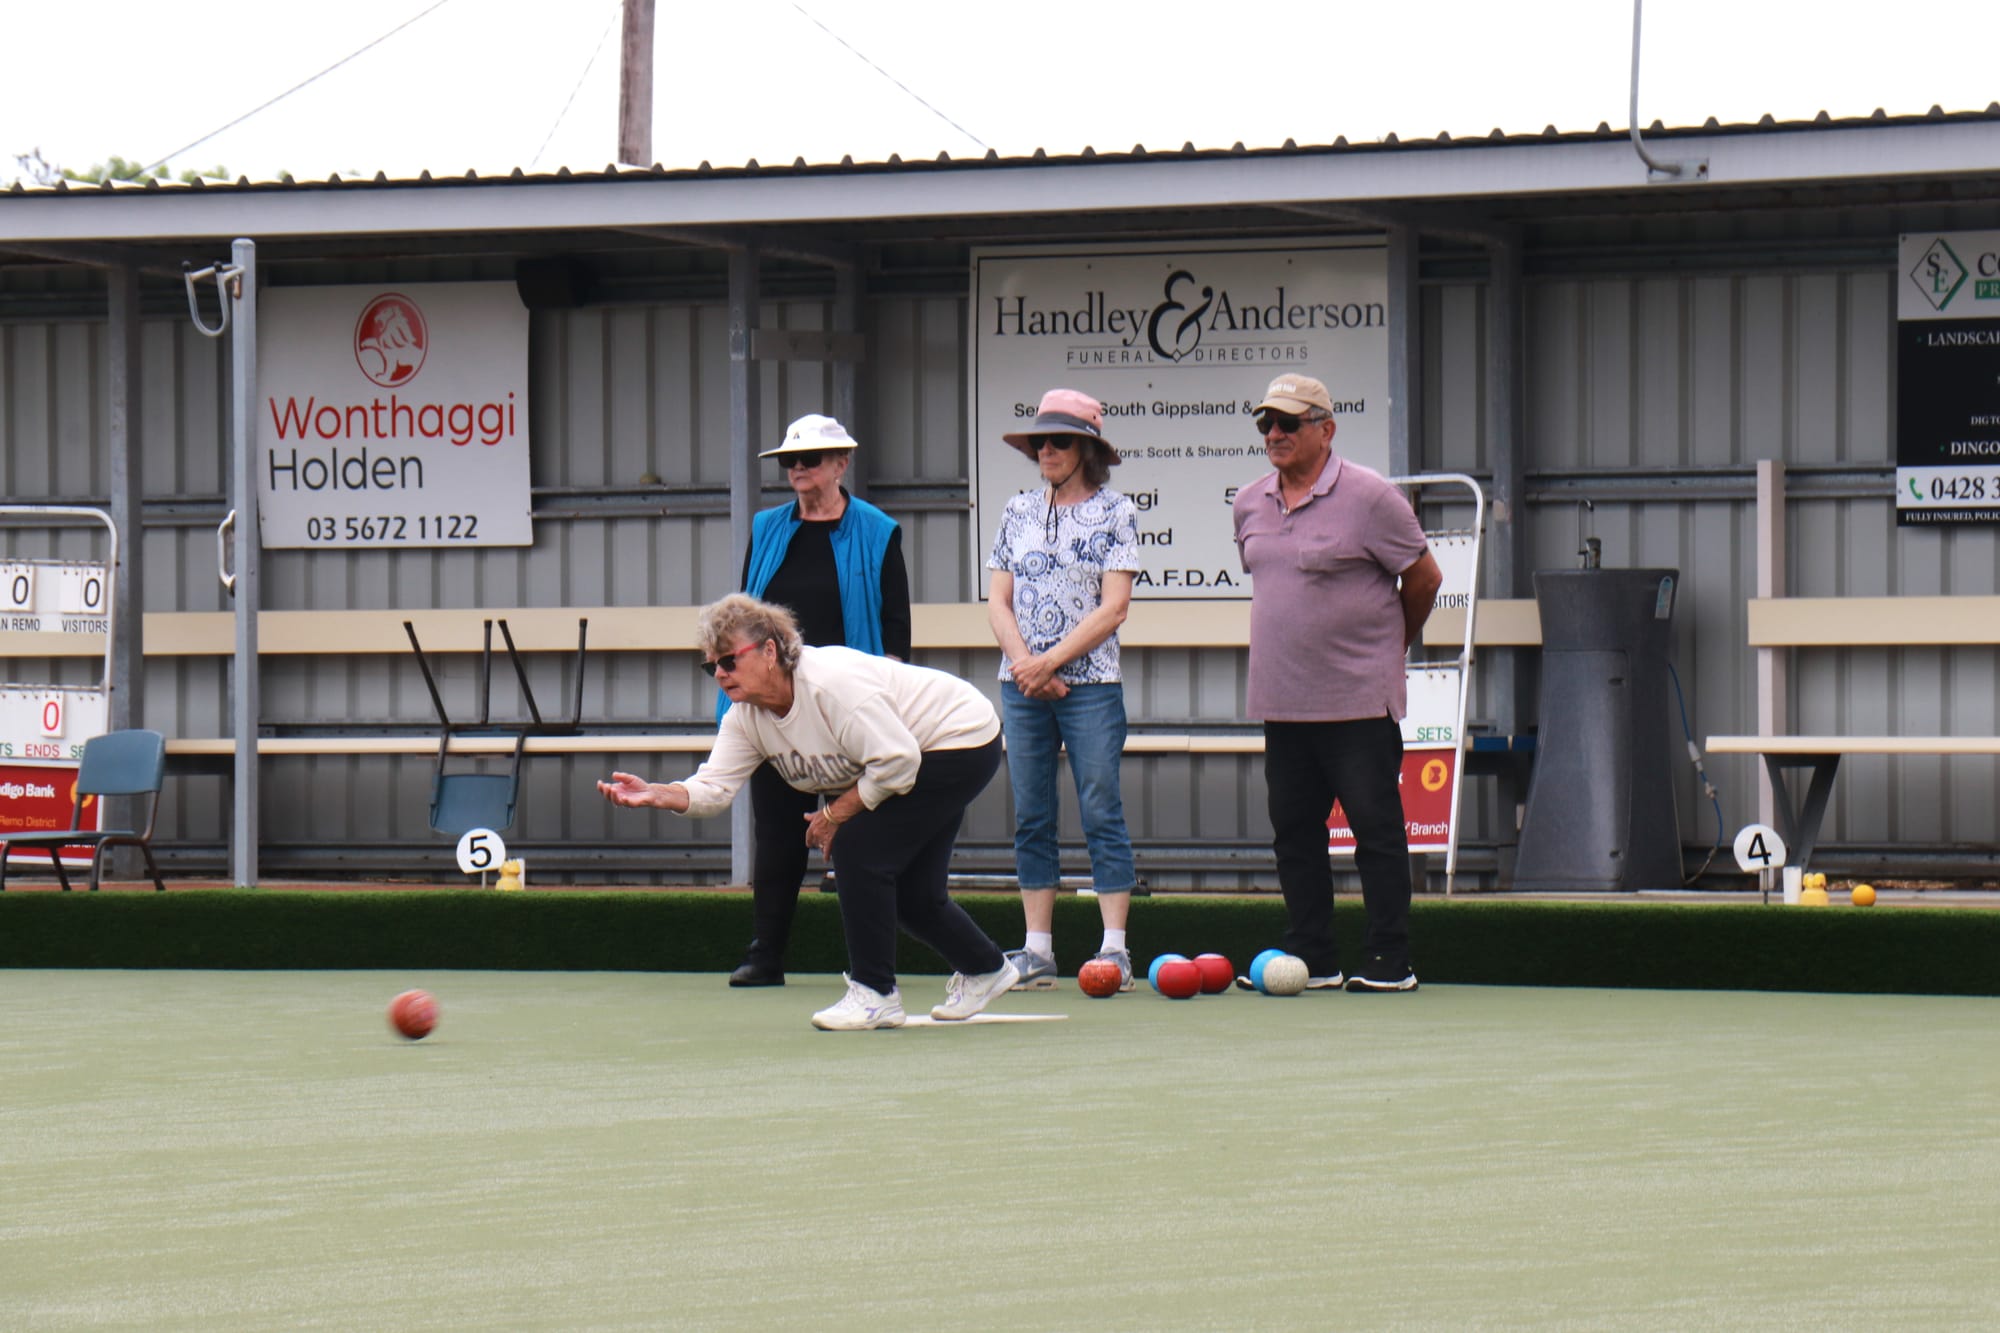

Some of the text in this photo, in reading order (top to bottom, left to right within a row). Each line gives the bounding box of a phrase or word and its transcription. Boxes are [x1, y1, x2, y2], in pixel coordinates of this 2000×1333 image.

[993, 270, 1386, 360] Handley & Anderson
[1066, 346, 1309, 364] FUNERAL DIRECTORS
[1100, 401, 1147, 416] South
[1151, 398, 1236, 418] Gippsland
[1241, 399, 1253, 415] &
[268, 392, 515, 446] Wonthaggi
[1147, 446, 1183, 458] Scott
[1185, 446, 1196, 457] &
[1199, 445, 1244, 457] Sharon
[1950, 440, 2000, 457] DINGO
[268, 446, 424, 491] Holden
[1930, 476, 1985, 501] 0428
[307, 514, 479, 541] 03 5672 1122
[1135, 568, 1240, 588] A.F.D.A.
[12, 575, 29, 605] 0
[84, 578, 101, 608] 0
[1433, 592, 1470, 609] ITORS
[12, 618, 41, 631] REMO
[61, 619, 108, 633] VISITORS
[43, 701, 60, 731] 0
[1416, 727, 1453, 741] SETS
[25, 743, 60, 758] ENDS
[25, 783, 56, 798] Bank
[25, 815, 57, 828] District
[1410, 822, 1449, 837] Branch
[470, 835, 492, 868] 5
[1748, 832, 1771, 865] 4
